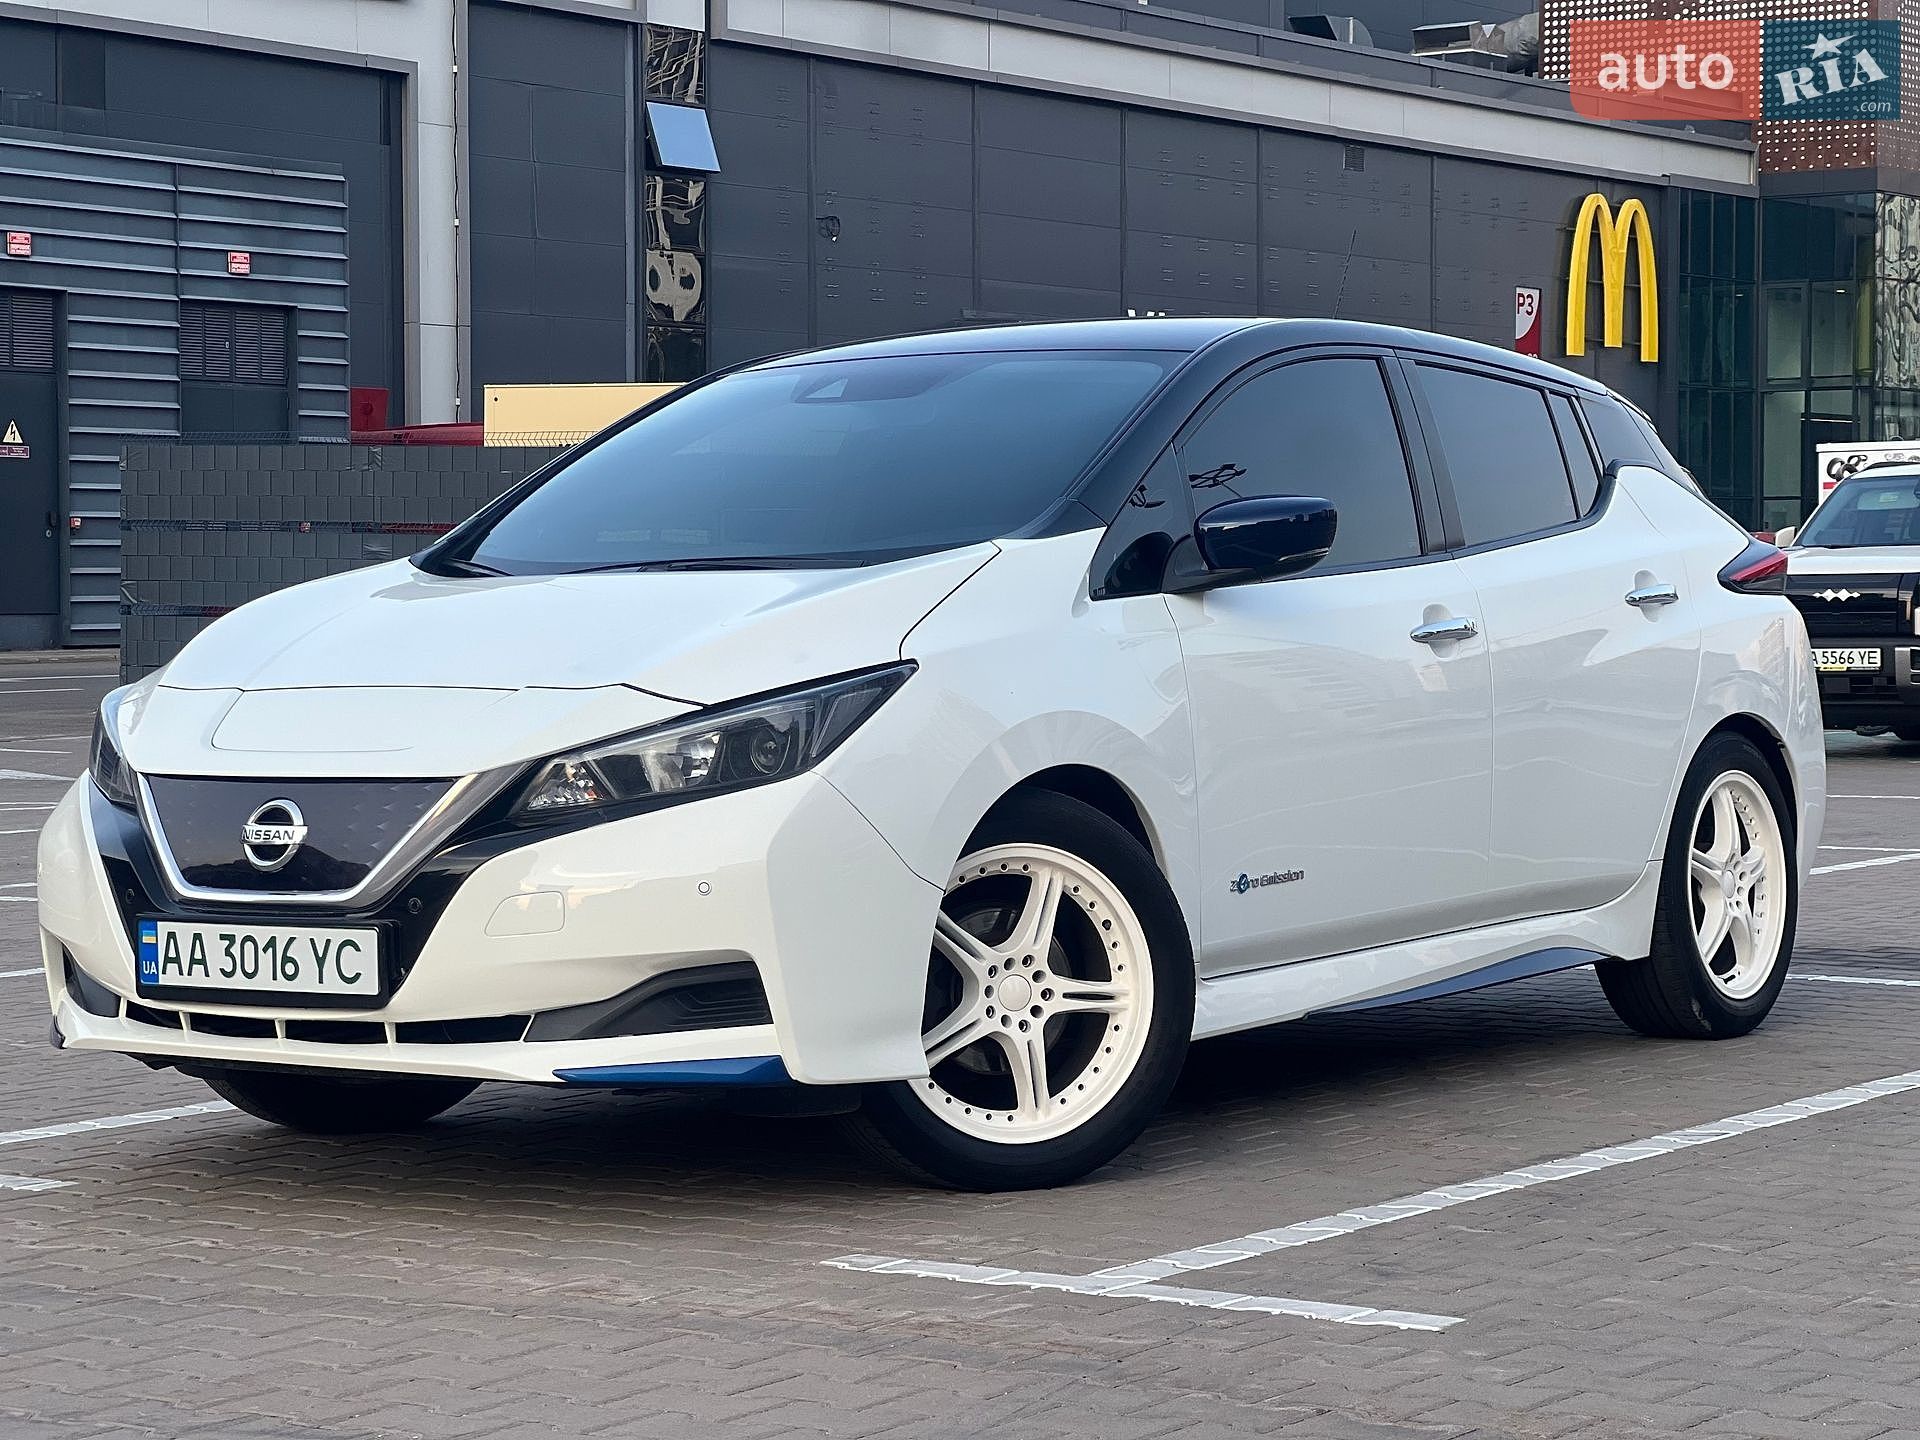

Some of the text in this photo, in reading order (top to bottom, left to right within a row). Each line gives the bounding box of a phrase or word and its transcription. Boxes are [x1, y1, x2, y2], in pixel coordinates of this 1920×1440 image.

[1516, 292, 1534, 316] P3
[1821, 650, 1855, 665] 5566
[1858, 650, 1878, 665] YE
[242, 828, 295, 841] NISSAN
[161, 931, 362, 985] AA 3016 YC
[142, 960, 158, 975] UA
